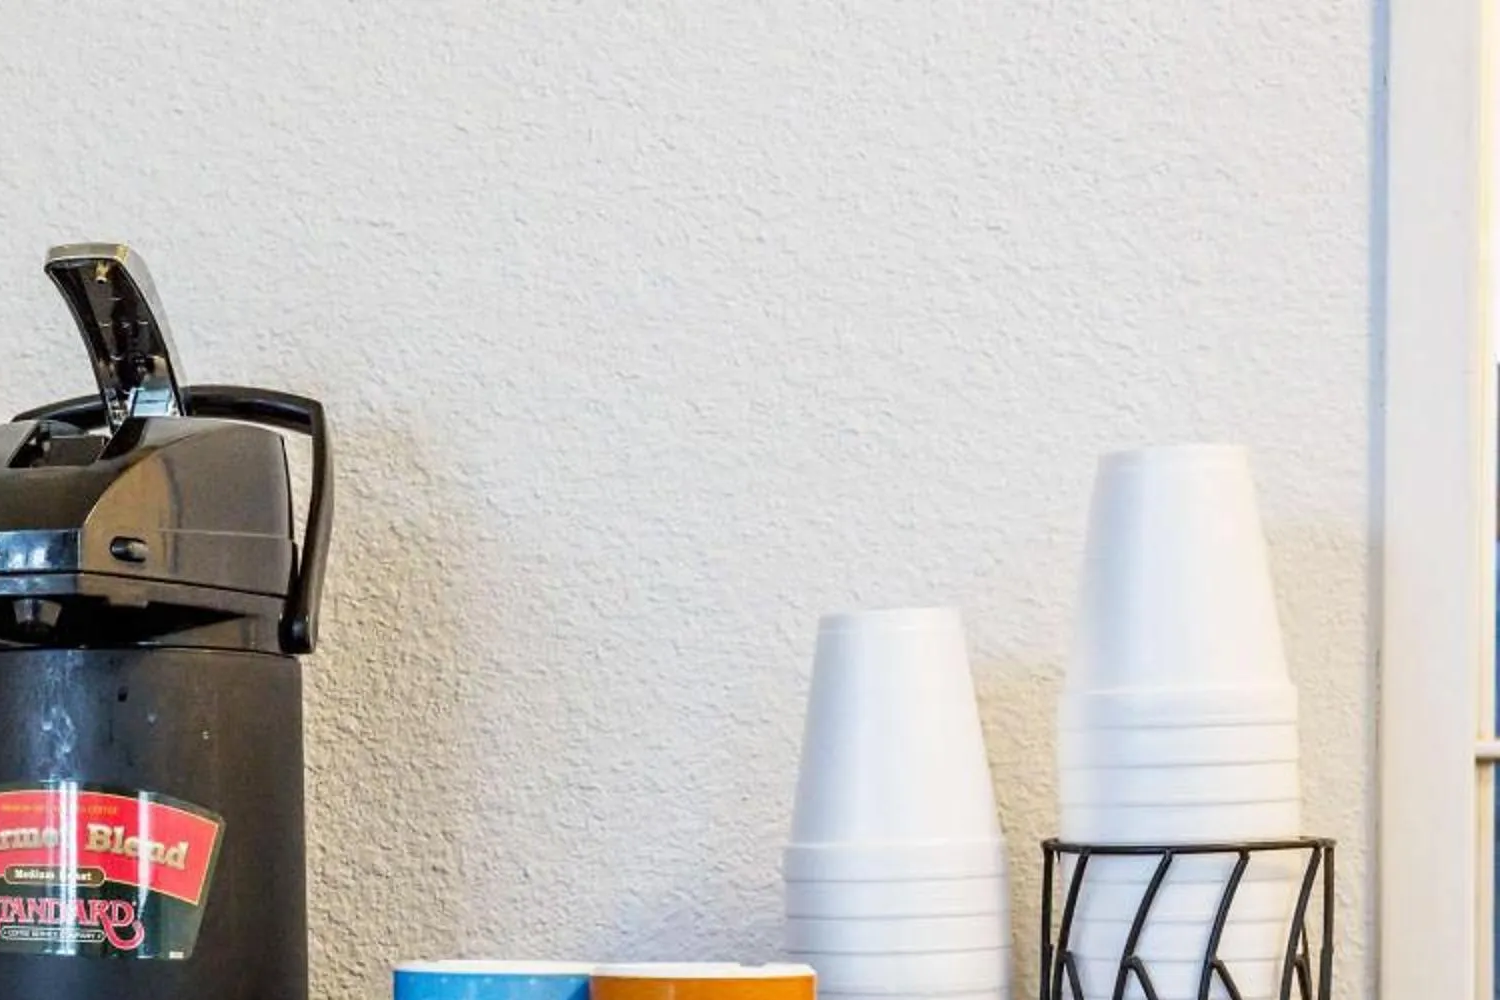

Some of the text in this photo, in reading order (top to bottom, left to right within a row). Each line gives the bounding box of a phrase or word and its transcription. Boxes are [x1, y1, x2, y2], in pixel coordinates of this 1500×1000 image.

[85, 822, 190, 871] Blend
[14, 869, 93, 881] Medium ast
